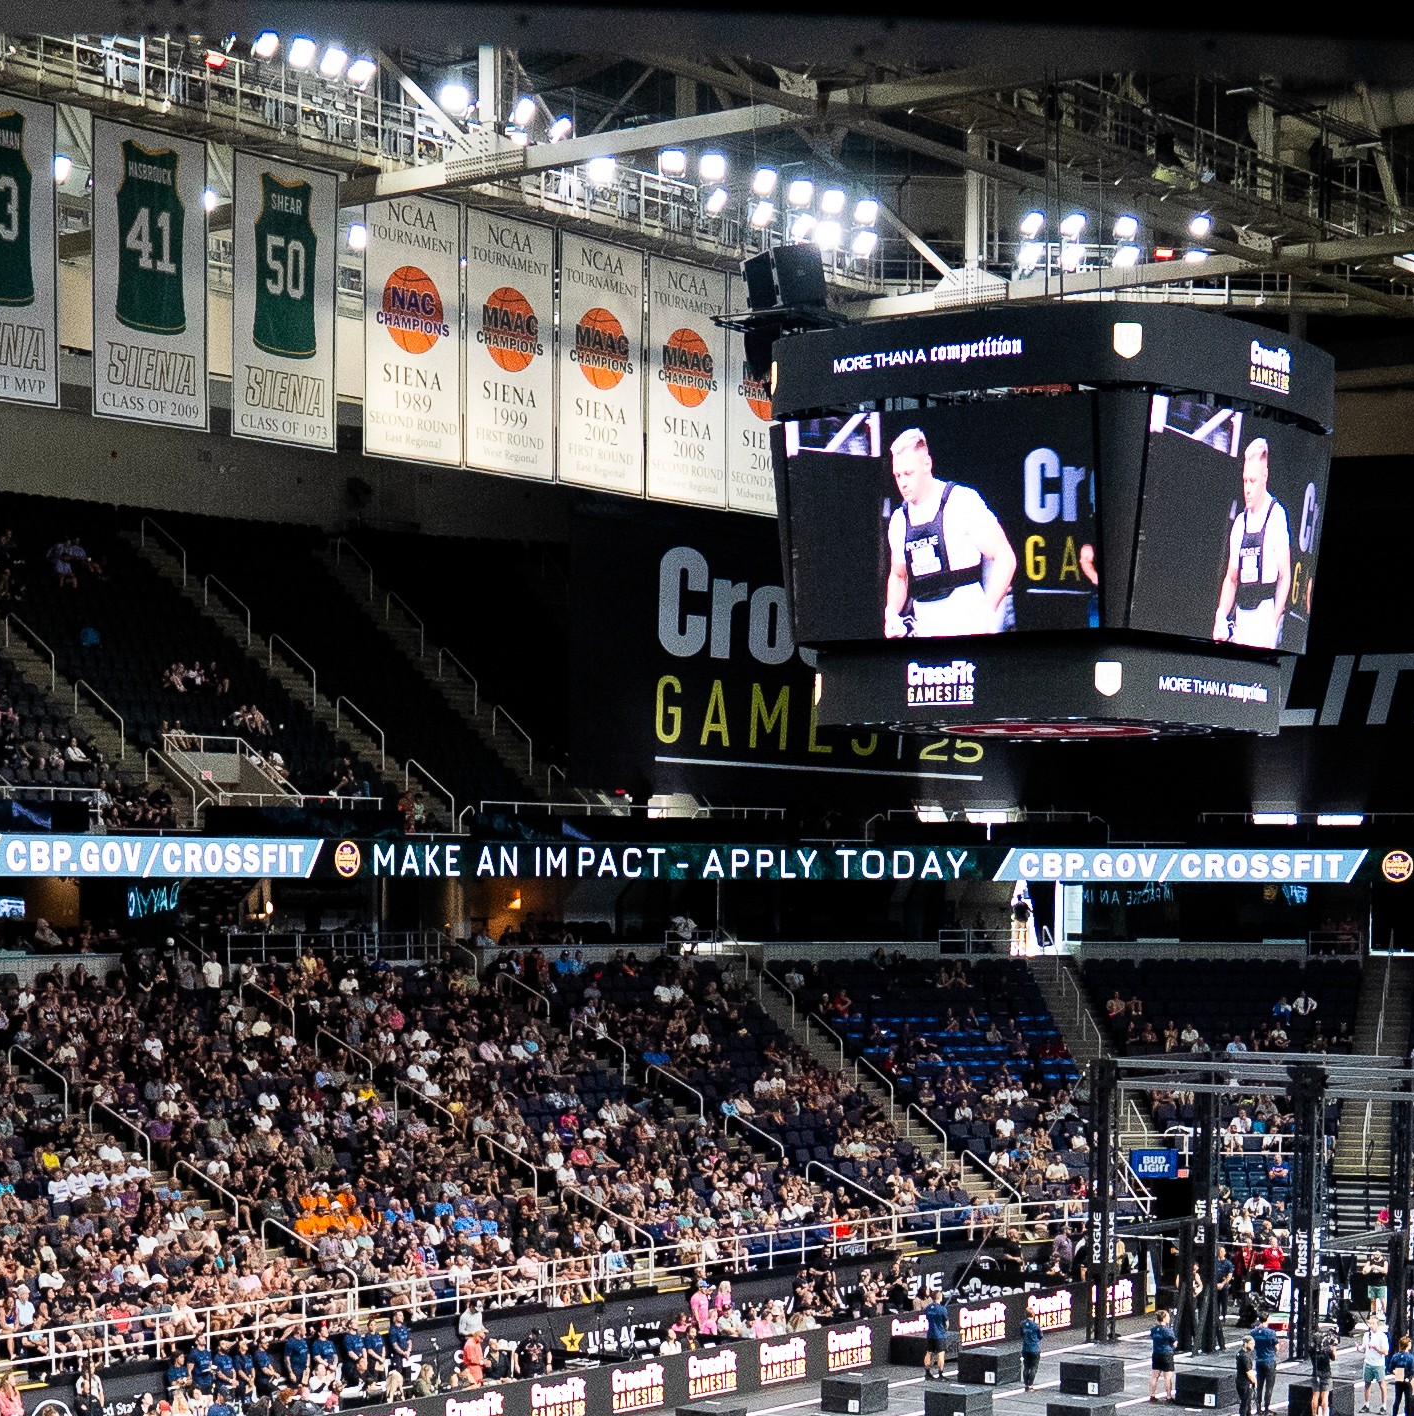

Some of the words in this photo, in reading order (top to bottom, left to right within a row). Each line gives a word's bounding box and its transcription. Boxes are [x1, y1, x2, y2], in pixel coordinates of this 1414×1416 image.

[271, 191, 303, 216] SHEAR
[388, 200, 437, 232] NCAA
[126, 207, 178, 274] 41
[370, 224, 454, 255] TOURNAMENT
[488, 223, 533, 254] NCAA
[265, 235, 305, 299] 50
[472, 246, 549, 277] TOURNAMENT
[389, 286, 436, 316] NAC
[376, 310, 450, 338] CHAMPIONS
[482, 304, 539, 336] MAAC
[476, 330, 544, 357] CHAMPIONS
[833, 355, 872, 373] MORE
[874, 349, 913, 367] THAN
[915, 349, 926, 363] A
[930, 335, 1022, 362] competition
[106, 340, 196, 396] SIENA
[569, 349, 634, 375] CHAMPIONS
[12, 375, 46, 395] MVP
[382, 363, 442, 391] SIENA
[657, 369, 718, 393] CHAMPIONS
[101, 391, 144, 412] CLASS
[147, 398, 166, 415] OF
[170, 400, 199, 419] 2009
[244, 365, 325, 418] SIENA
[394, 390, 432, 414] 1989
[482, 380, 538, 409] SIENA
[493, 407, 528, 428] 1999
[575, 398, 627, 425] SIENA
[240, 413, 280, 433] CLASS
[282, 419, 299, 435] OF
[302, 422, 328, 440] 1973
[584, 424, 619, 445] 2002
[663, 416, 713, 441] SIENA
[672, 441, 705, 461] 2008
[907, 660, 977, 687] CrossFit
[907, 685, 952, 703] GAMES
[373, 845, 462, 877] MAKE
[477, 846, 519, 877] AN
[534, 846, 666, 878] IMPACT
[703, 847, 817, 879] APPLY
[835, 849, 968, 880] TODAY
[1138, 1162, 1170, 1173] LIGHT
[1142, 1155, 1166, 1165] BUD
[1093, 1212, 1101, 1264] ROGUE
[1295, 1229, 1308, 1278] CrossFit
